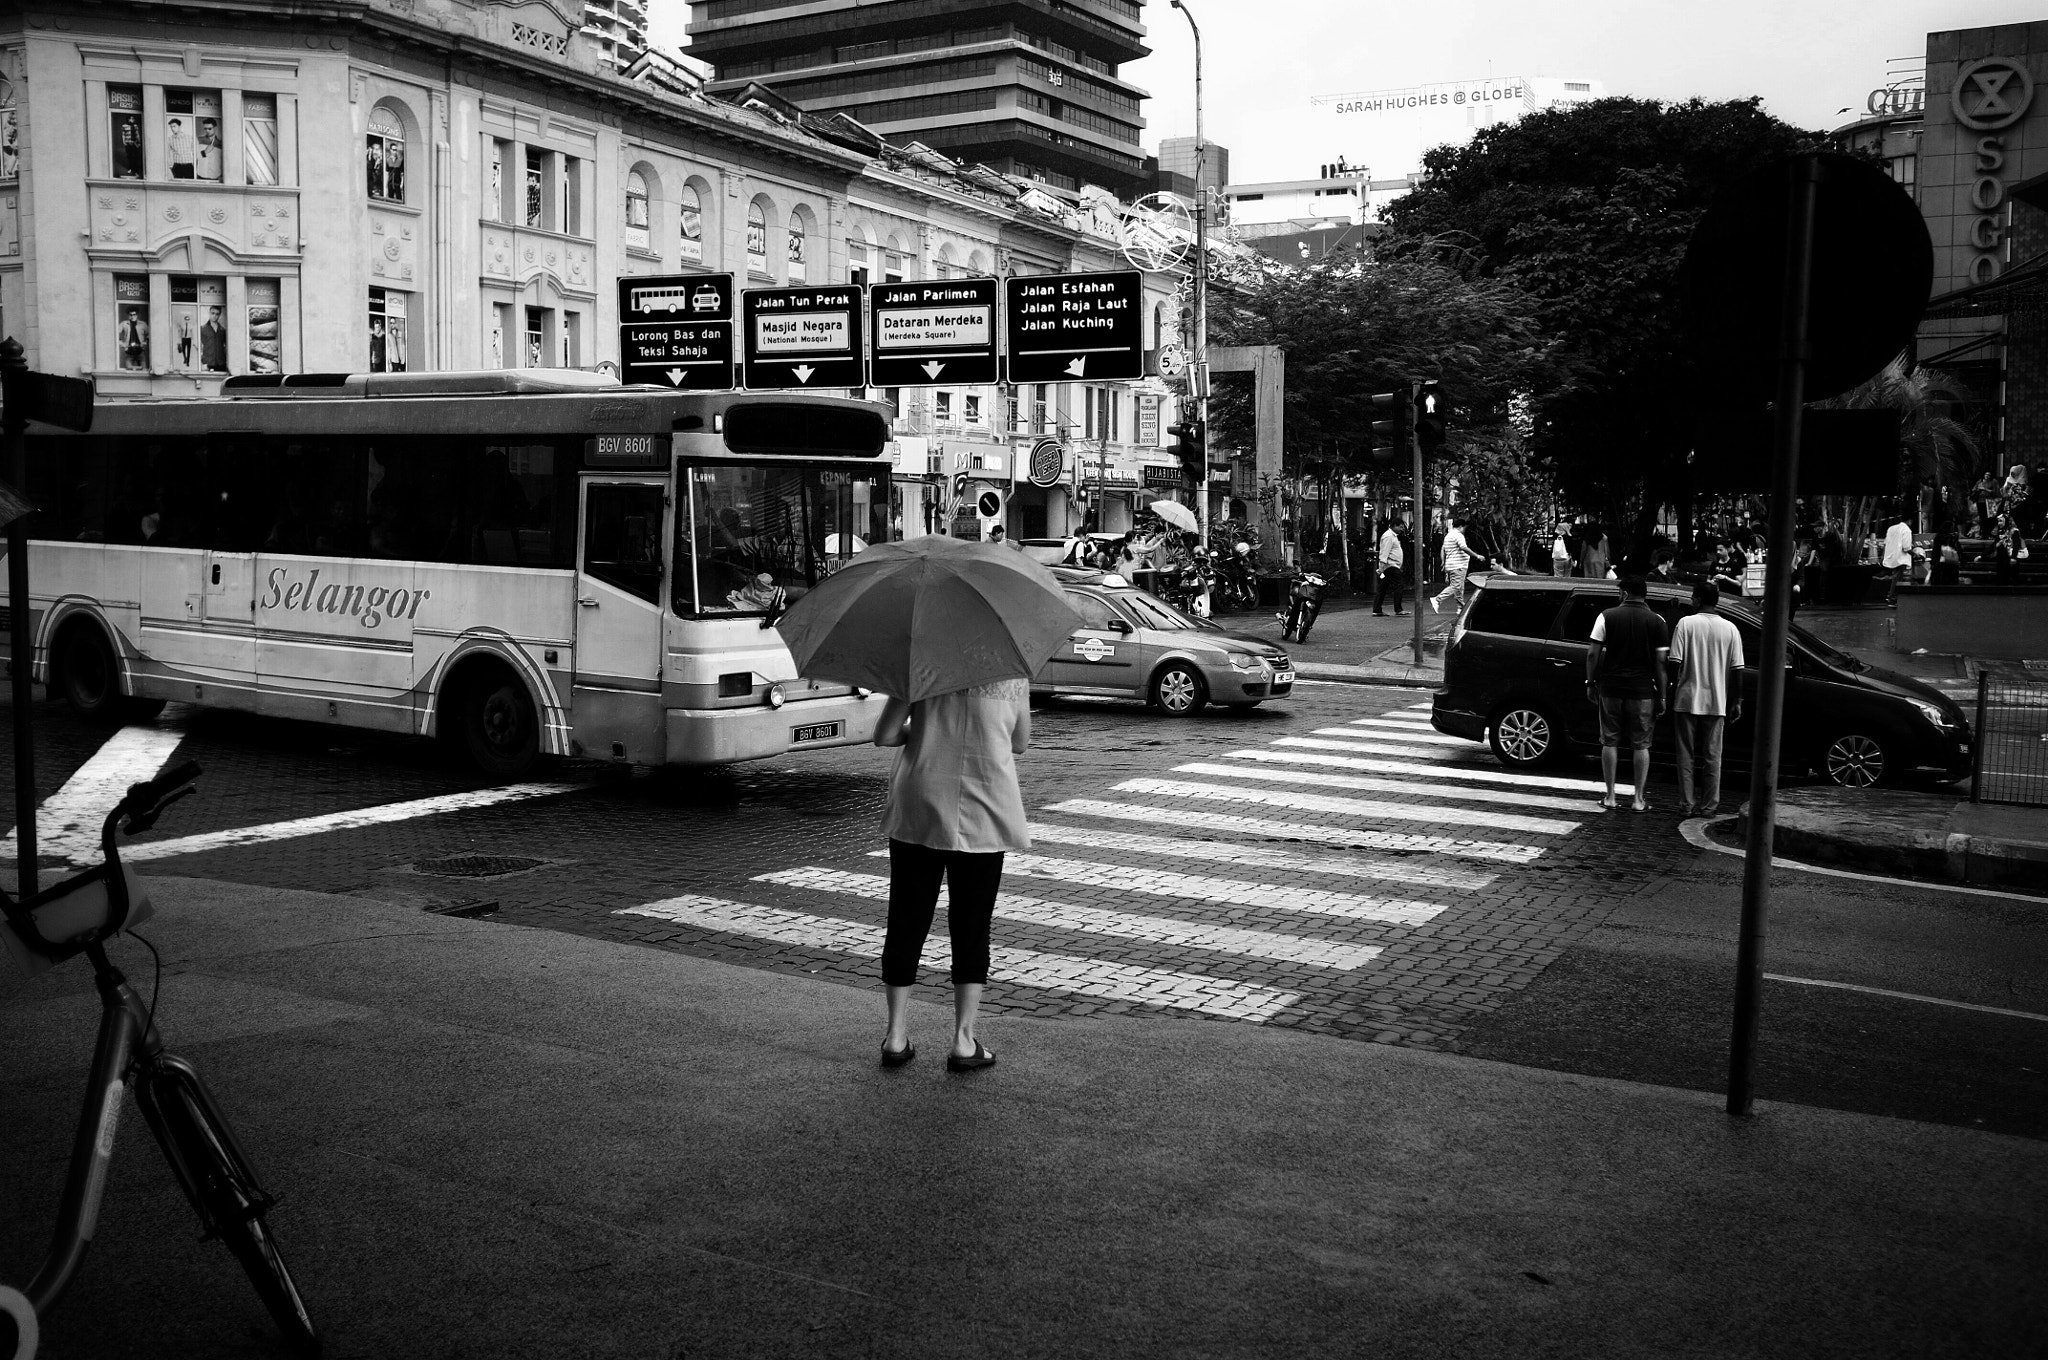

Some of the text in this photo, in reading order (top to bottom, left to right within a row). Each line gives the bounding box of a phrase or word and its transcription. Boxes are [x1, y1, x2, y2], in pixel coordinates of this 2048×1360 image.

[1336, 86, 1523, 114] SARAH HUGHES @ GLOBE
[1969, 136, 2004, 286] SOGO
[884, 288, 977, 303] Jalan Parlimen
[1020, 282, 1115, 297] Jalan Esfahan
[755, 294, 849, 308] Jalan Tun Perak
[1020, 298, 1128, 314] Jalan Raja Laut
[762, 321, 842, 334] Masjid Negara
[884, 315, 983, 329] Dataran Merdeka
[1020, 317, 1114, 331] Jalan Kuching
[631, 328, 721, 343] Lorong Bas dan
[924, 330, 956, 341] Square)
[639, 346, 708, 358] Teksi Sahaja
[598, 437, 651, 452] BGV 8601
[820, 470, 851, 485] KEPONG
[1146, 466, 1182, 479] HIJABISTA
[260, 567, 431, 629] Selangor
[815, 726, 832, 738] 8601
